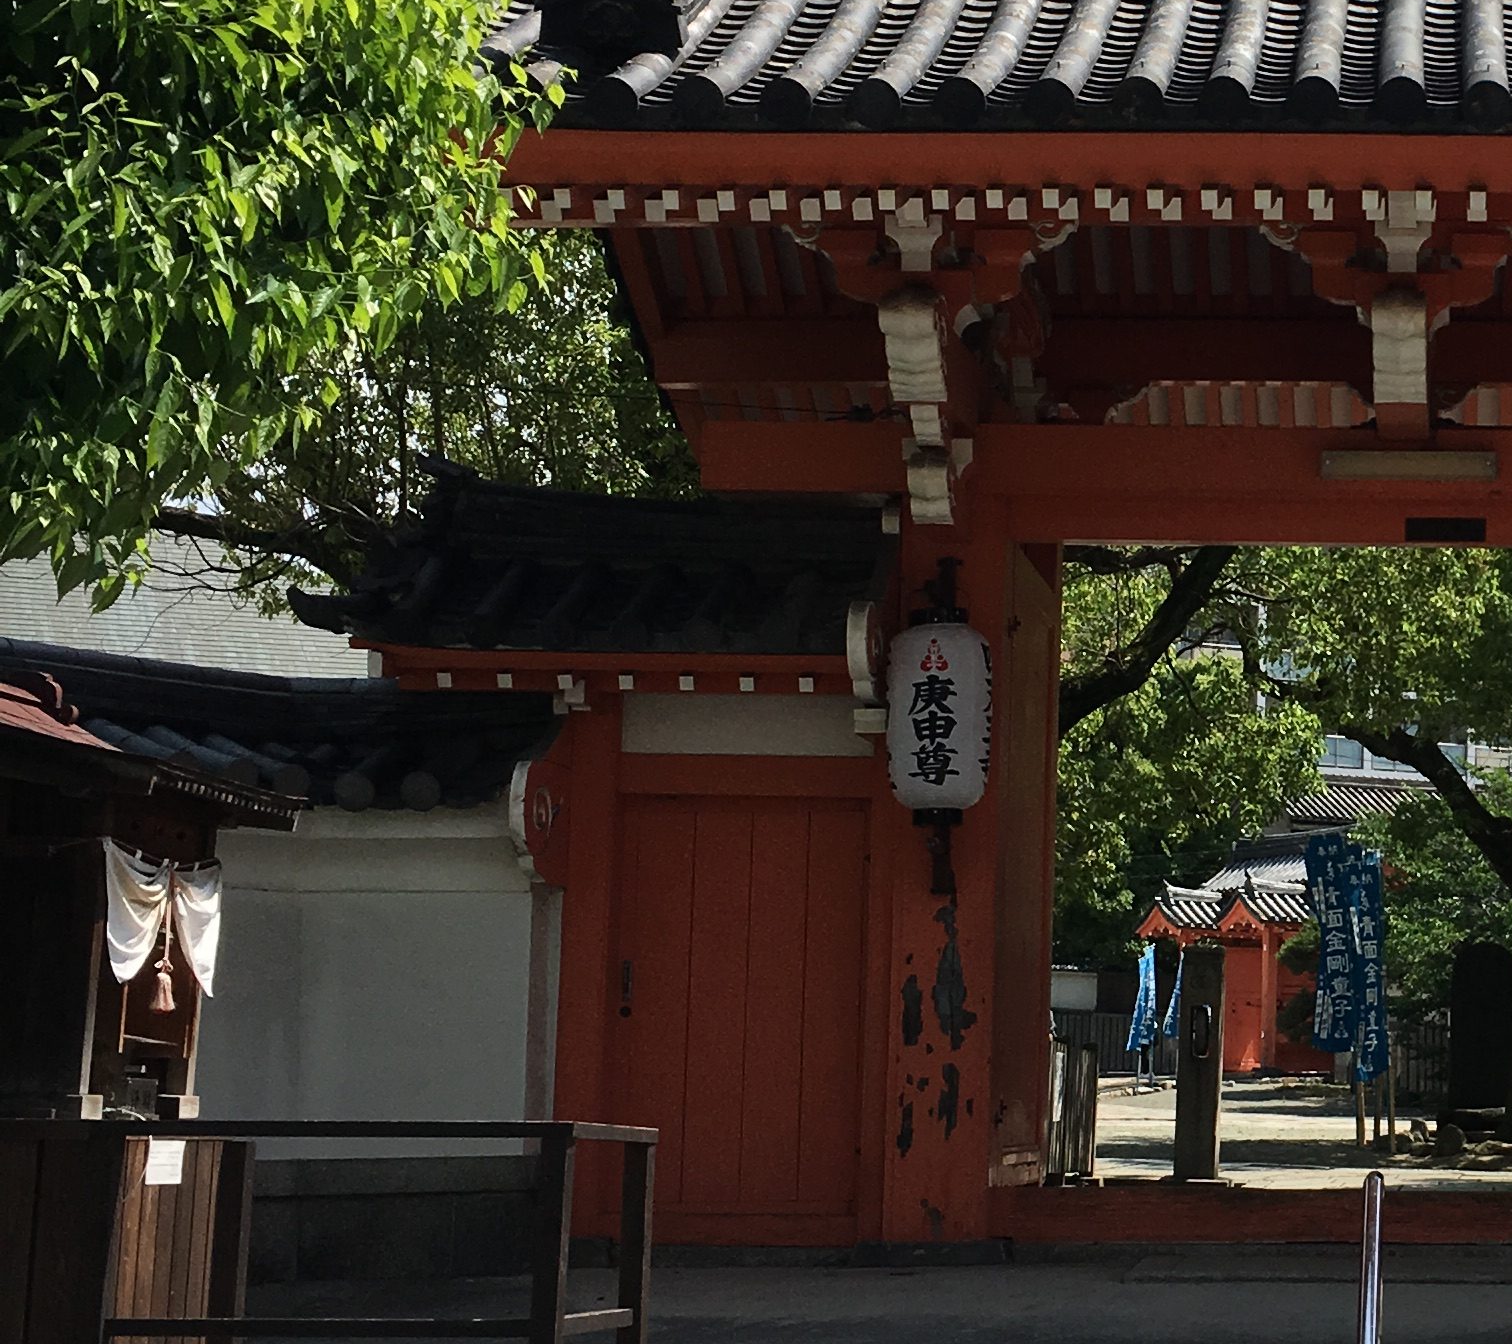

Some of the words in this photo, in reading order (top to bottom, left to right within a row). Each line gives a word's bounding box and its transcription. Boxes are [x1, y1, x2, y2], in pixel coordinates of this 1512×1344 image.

[908, 674, 960, 786] 庚申尊
[1326, 886, 1352, 1018] 青面金剛童子
